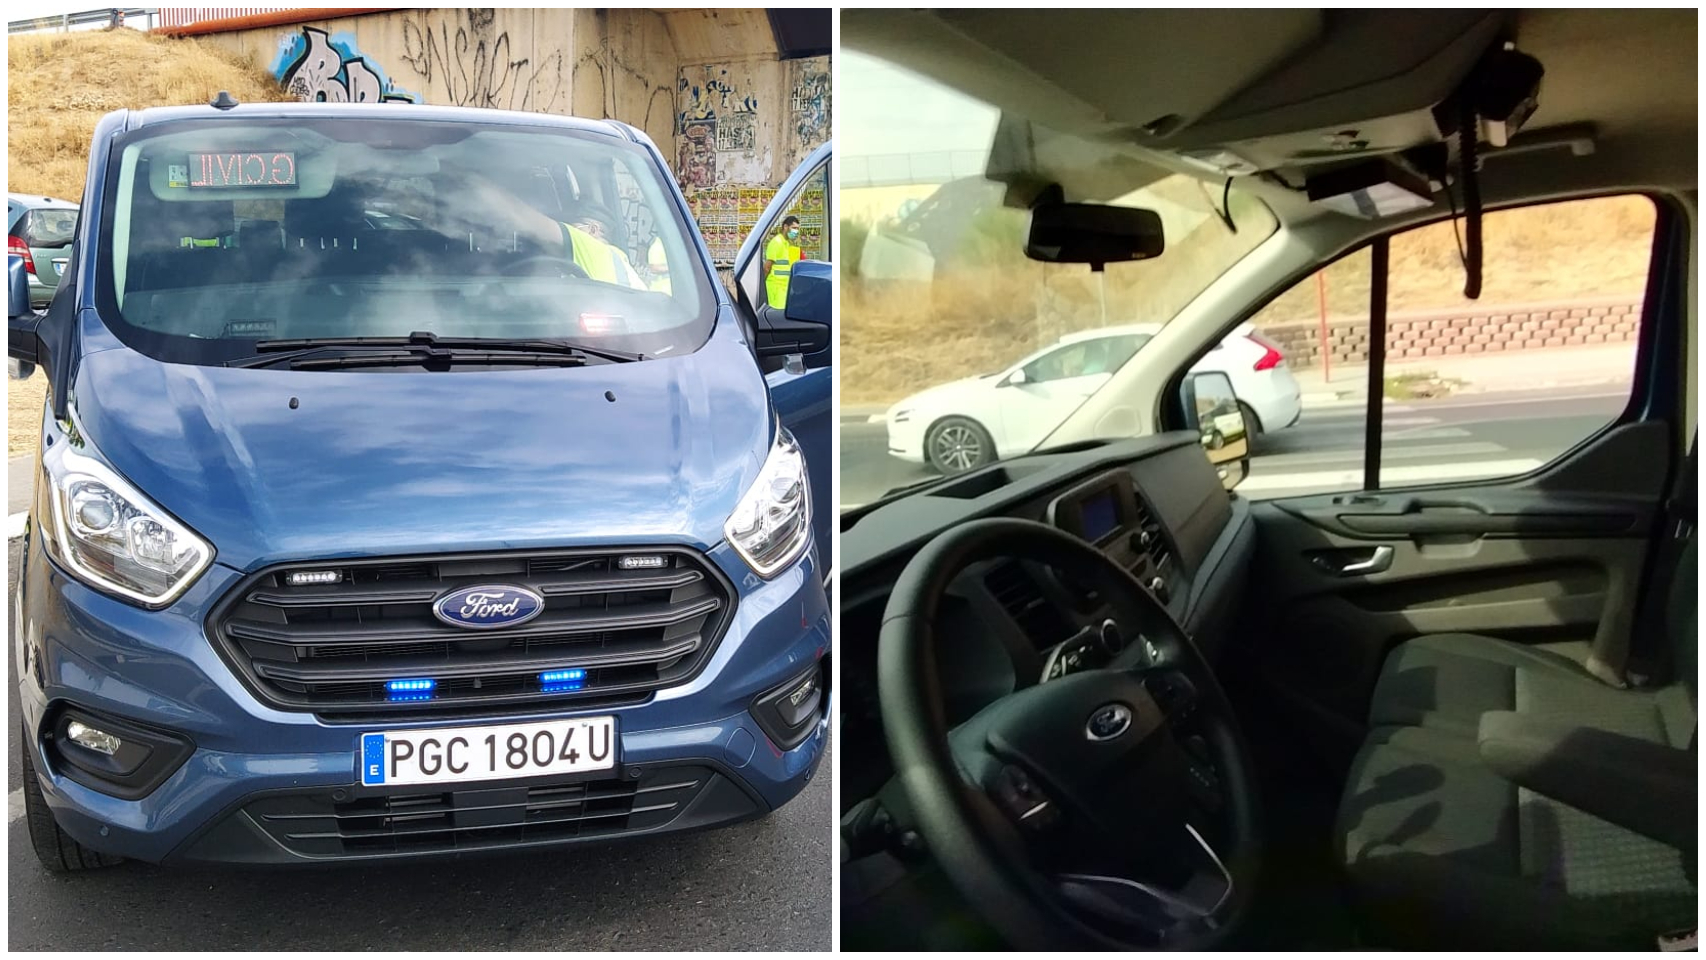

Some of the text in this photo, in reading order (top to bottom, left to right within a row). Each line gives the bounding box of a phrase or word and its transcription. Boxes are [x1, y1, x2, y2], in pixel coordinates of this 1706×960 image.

[460, 592, 520, 619] Ford
[370, 765, 379, 776] E
[390, 736, 470, 778] PGC
